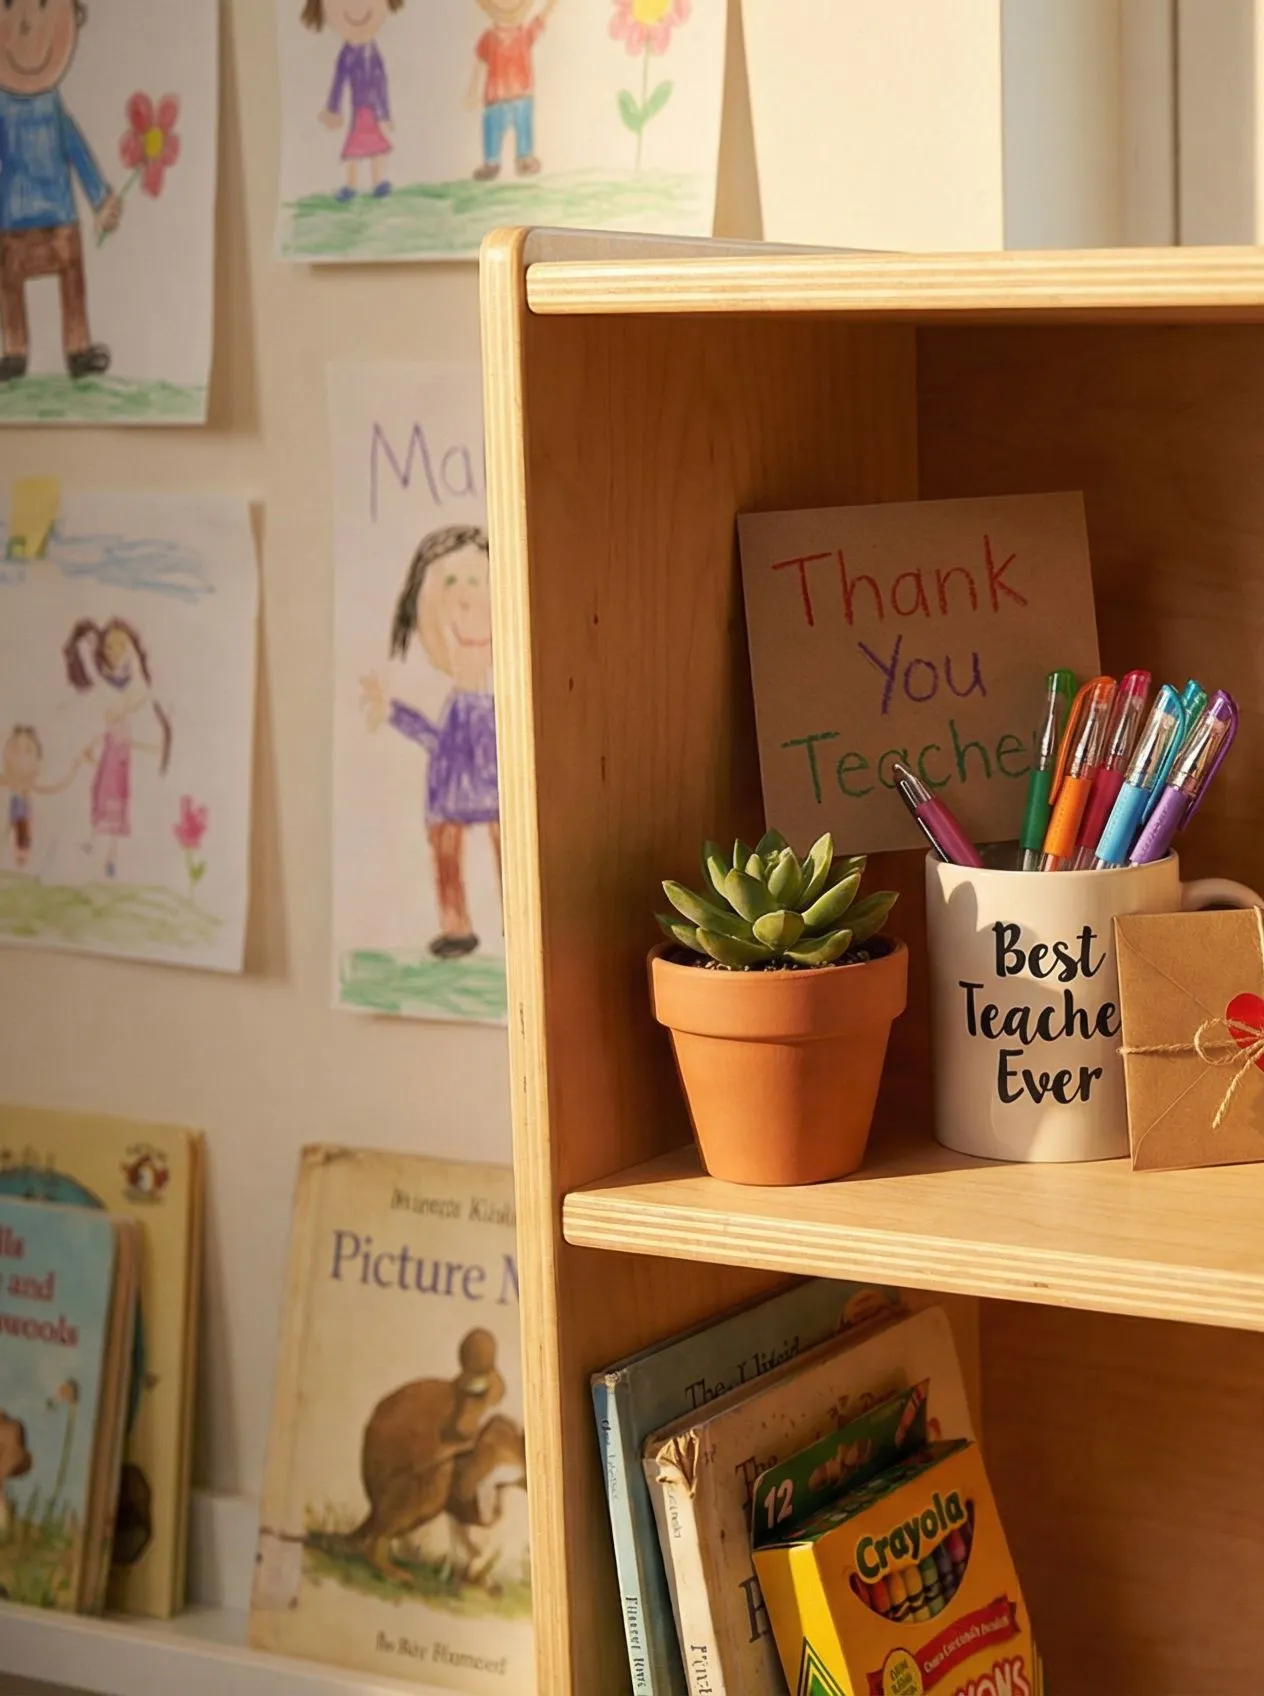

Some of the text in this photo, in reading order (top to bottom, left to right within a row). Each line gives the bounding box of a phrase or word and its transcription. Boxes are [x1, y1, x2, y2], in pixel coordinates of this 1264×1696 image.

[771, 534, 1028, 627] Thank
[857, 634, 987, 715] You
[781, 719, 1038, 804] Teache
[992, 920, 1107, 983] Best
[958, 980, 1121, 1045] Teache
[998, 1048, 1103, 1104] Ever
[330, 1229, 487, 1301] Picture
[763, 1478, 794, 1530] 12
[855, 1491, 965, 1579] Crayola
